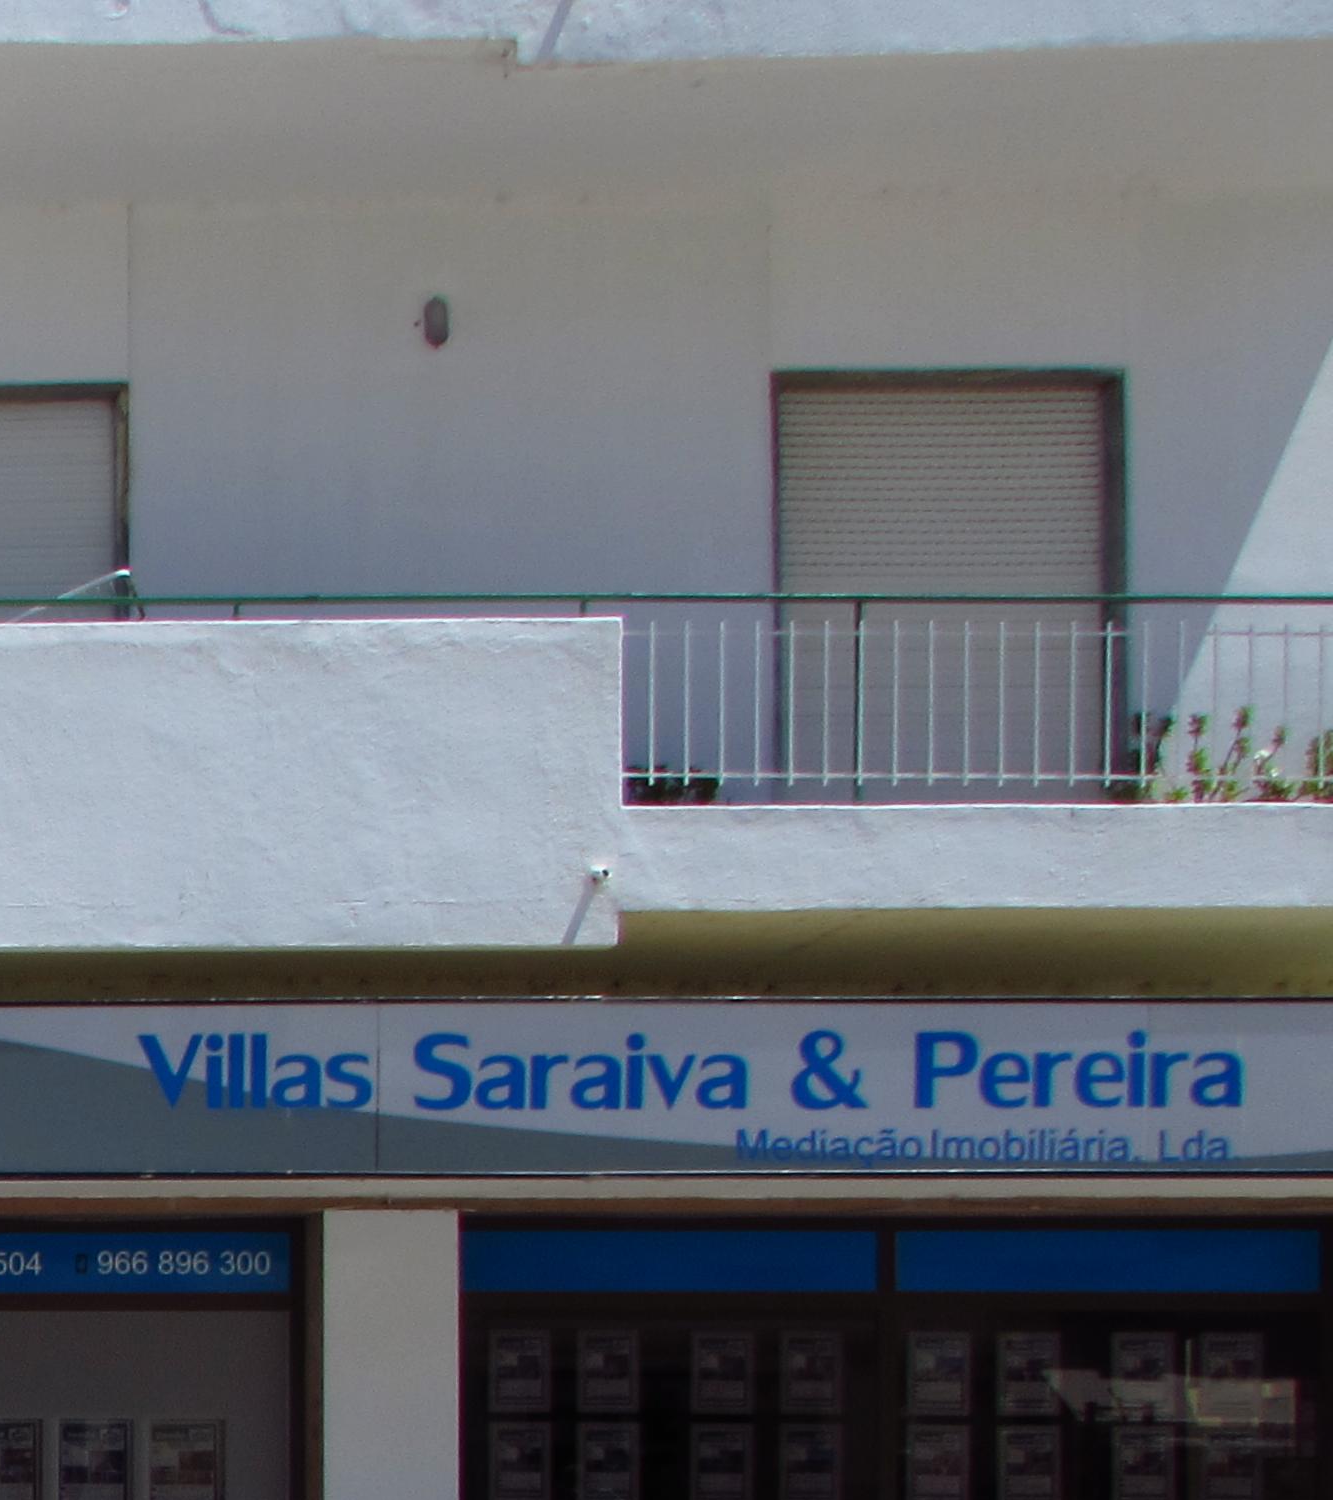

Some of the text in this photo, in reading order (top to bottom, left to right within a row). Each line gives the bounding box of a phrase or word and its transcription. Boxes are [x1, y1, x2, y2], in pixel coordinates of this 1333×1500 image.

[138, 1028, 1246, 1111] Villas Saraiva & Pereira
[734, 1126, 922, 1168] Mediação
[1159, 1128, 1231, 1162] Lda
[96, 1250, 149, 1276] 966
[158, 1250, 210, 1276] 896
[219, 1250, 271, 1276] 300
